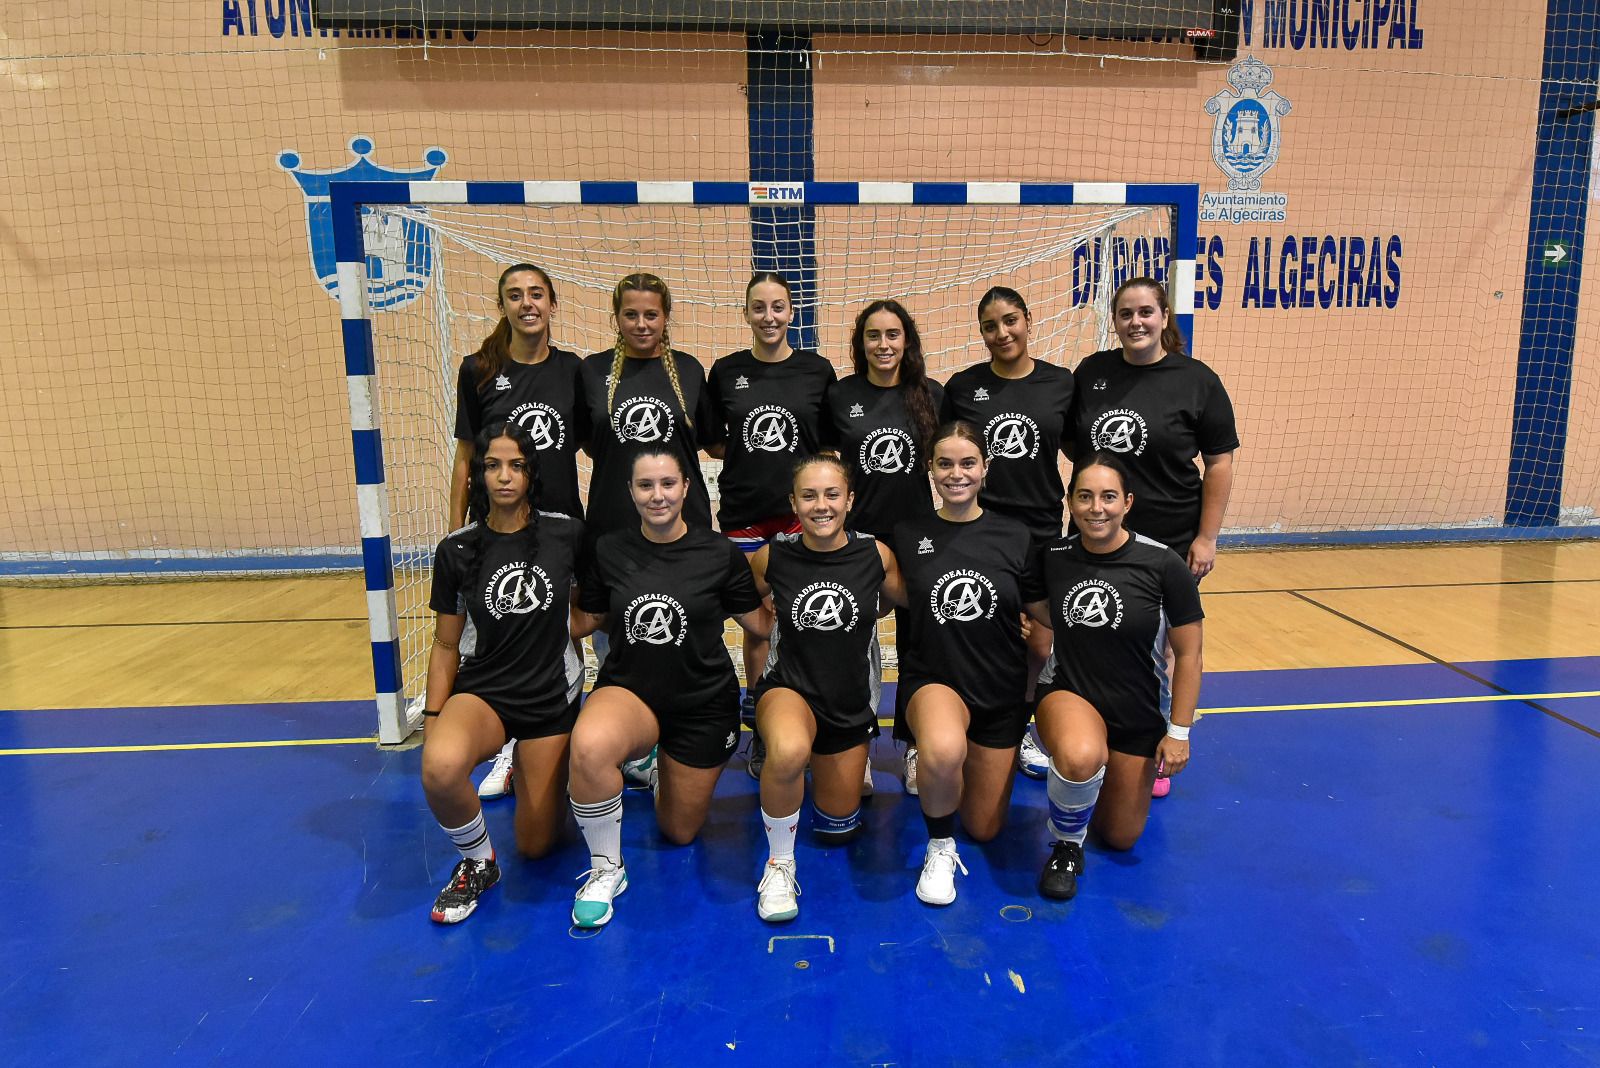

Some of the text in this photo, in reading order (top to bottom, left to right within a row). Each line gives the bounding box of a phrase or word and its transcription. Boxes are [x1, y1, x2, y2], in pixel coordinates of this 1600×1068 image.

[1263, 0, 1423, 50] MUNICIPAL
[1200, 208, 1285, 223] de Algeciras
[1202, 194, 1286, 207] Ayuntamiento
[1241, 235, 1402, 310] ALGECIRAS
[506, 402, 566, 451] ADDEALGECIRAS.COM
[742, 405, 799, 453] BMCIUDADDEALGECIRAS.COM
[484, 561, 554, 620] BMCIUDADDEALGCIRAS.COM
[791, 581, 860, 632] BMCIUDADDEALGECIRAS.COM
[930, 568, 998, 625] BMCIUDADDEALGECIRAS.COM
[1062, 579, 1124, 630] BMCIUDADDEALGECIRAS.COM
